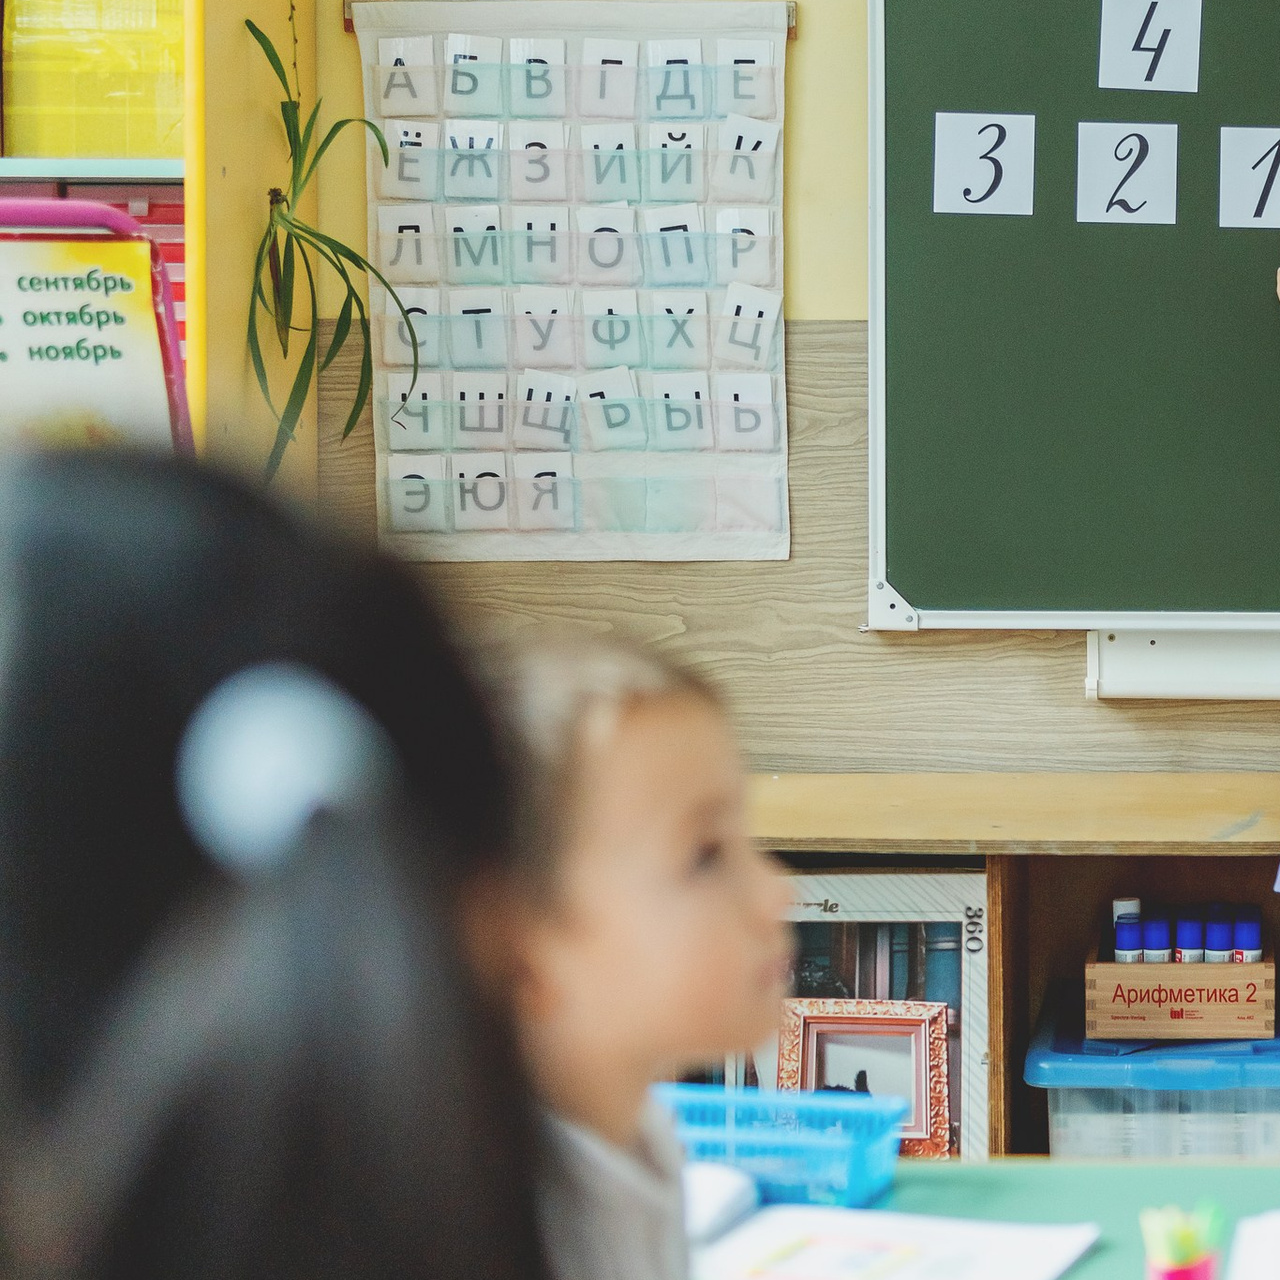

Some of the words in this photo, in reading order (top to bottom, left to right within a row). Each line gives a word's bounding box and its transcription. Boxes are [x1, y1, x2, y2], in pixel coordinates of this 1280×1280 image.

[1132, 1, 1172, 82] 4
[384, 57, 417, 99] А
[451, 54, 478, 95] Б
[526, 58, 553, 100] В
[600, 59, 623, 100] Г
[656, 59, 696, 111] Д
[733, 59, 756, 100] Е
[398, 131, 422, 182] Ё
[450, 136, 494, 178] Ж
[525, 142, 550, 184] З
[593, 143, 627, 185] И
[661, 132, 692, 184] Й
[729, 135, 762, 180] К
[963, 123, 1007, 203] 3
[1105, 133, 1149, 213] 2
[389, 225, 423, 266] Л
[453, 225, 499, 267] М
[526, 223, 556, 263] Н
[588, 227, 624, 268] О
[659, 224, 694, 267] П
[732, 228, 757, 268] Р
[17, 269, 133, 297] сентябрь
[23, 303, 125, 331] октябрь
[398, 307, 428, 348] С
[462, 308, 492, 349] Т
[525, 309, 558, 351] У
[592, 308, 630, 350] Ф
[665, 308, 694, 350] Х
[728, 305, 764, 361] Ц
[28, 338, 122, 365] ноябрь
[401, 392, 429, 433] Ч
[459, 391, 504, 433] Ш
[522, 388, 572, 444] Щ
[664, 391, 704, 431] Ы
[403, 474, 431, 513] Э
[459, 471, 506, 511] Ю
[532, 471, 559, 511] Я
[965, 906, 984, 953] 360
[1112, 984, 1239, 1008] Арифметика
[1246, 982, 1257, 1002] 2
